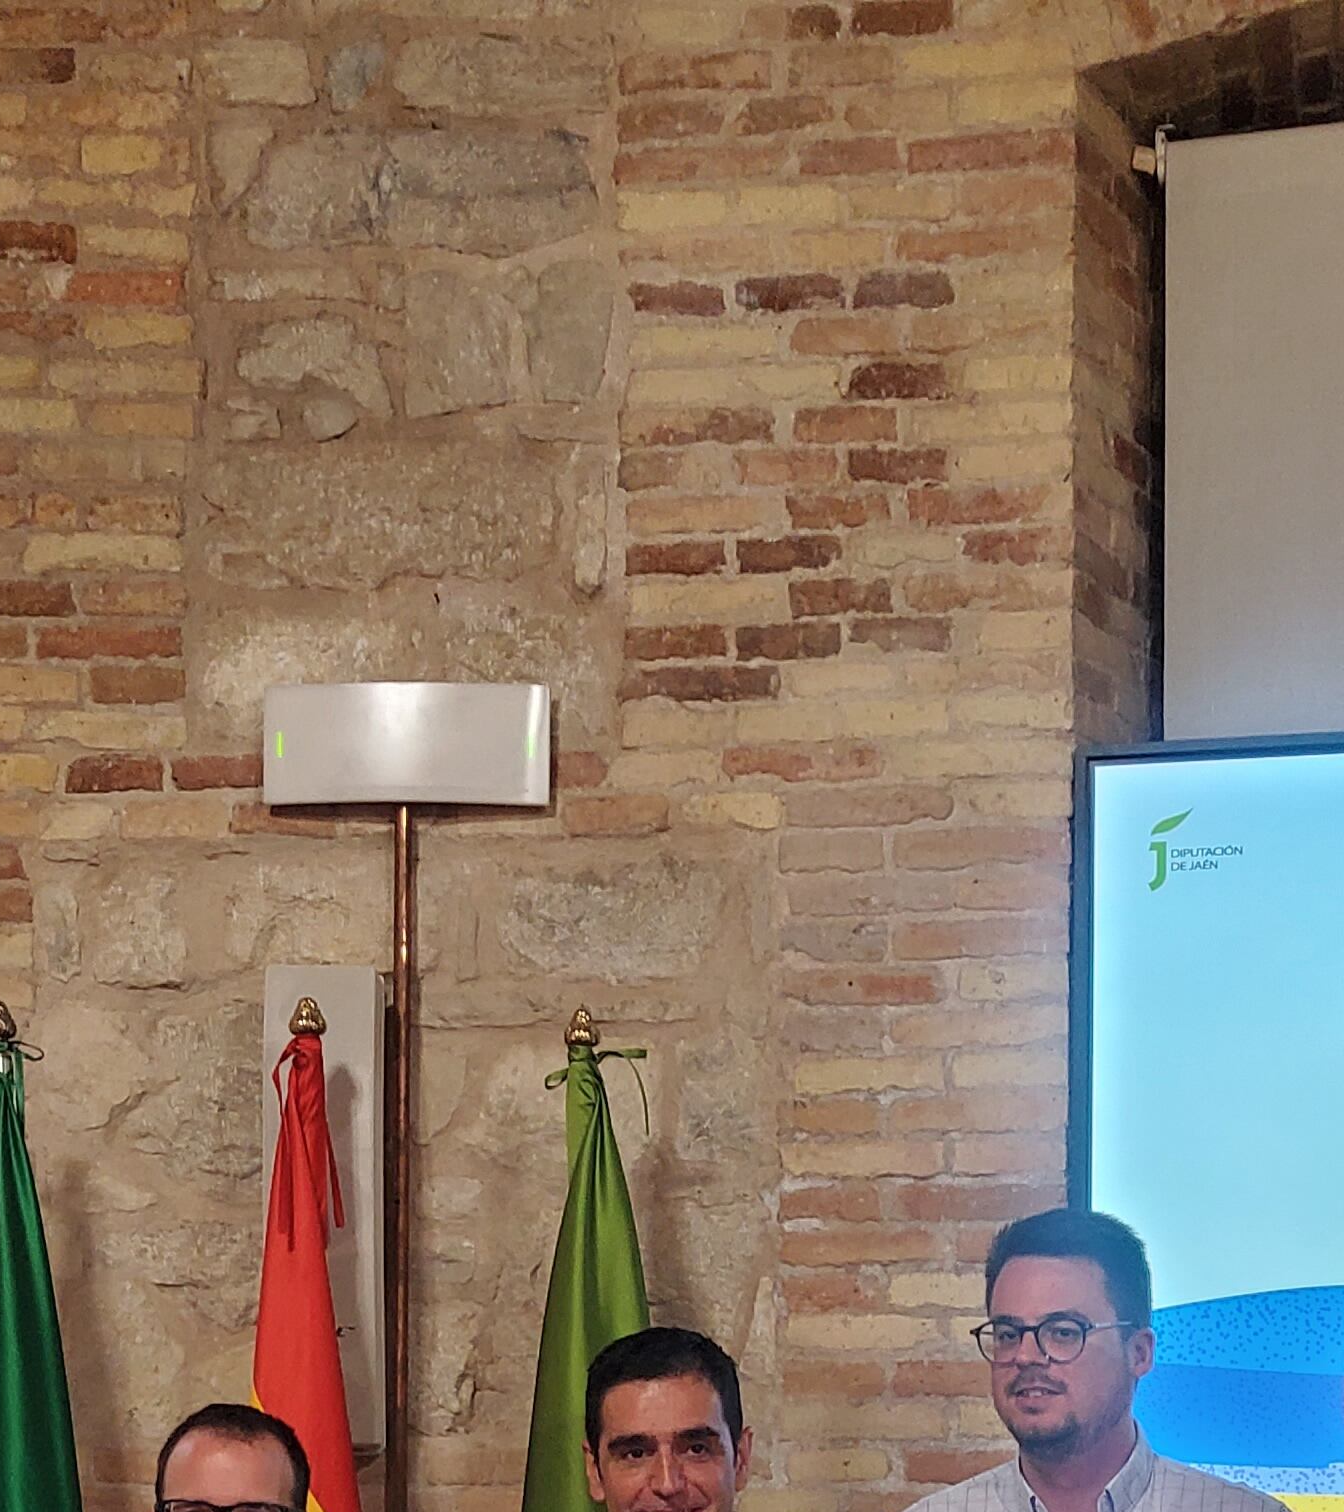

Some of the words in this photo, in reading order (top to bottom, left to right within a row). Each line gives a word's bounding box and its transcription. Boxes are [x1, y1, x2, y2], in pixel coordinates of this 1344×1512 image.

[1170, 845, 1243, 858] DIPUTACIÓN
[1170, 861, 1187, 871] DE
[1188, 859, 1218, 871] JAÉN
